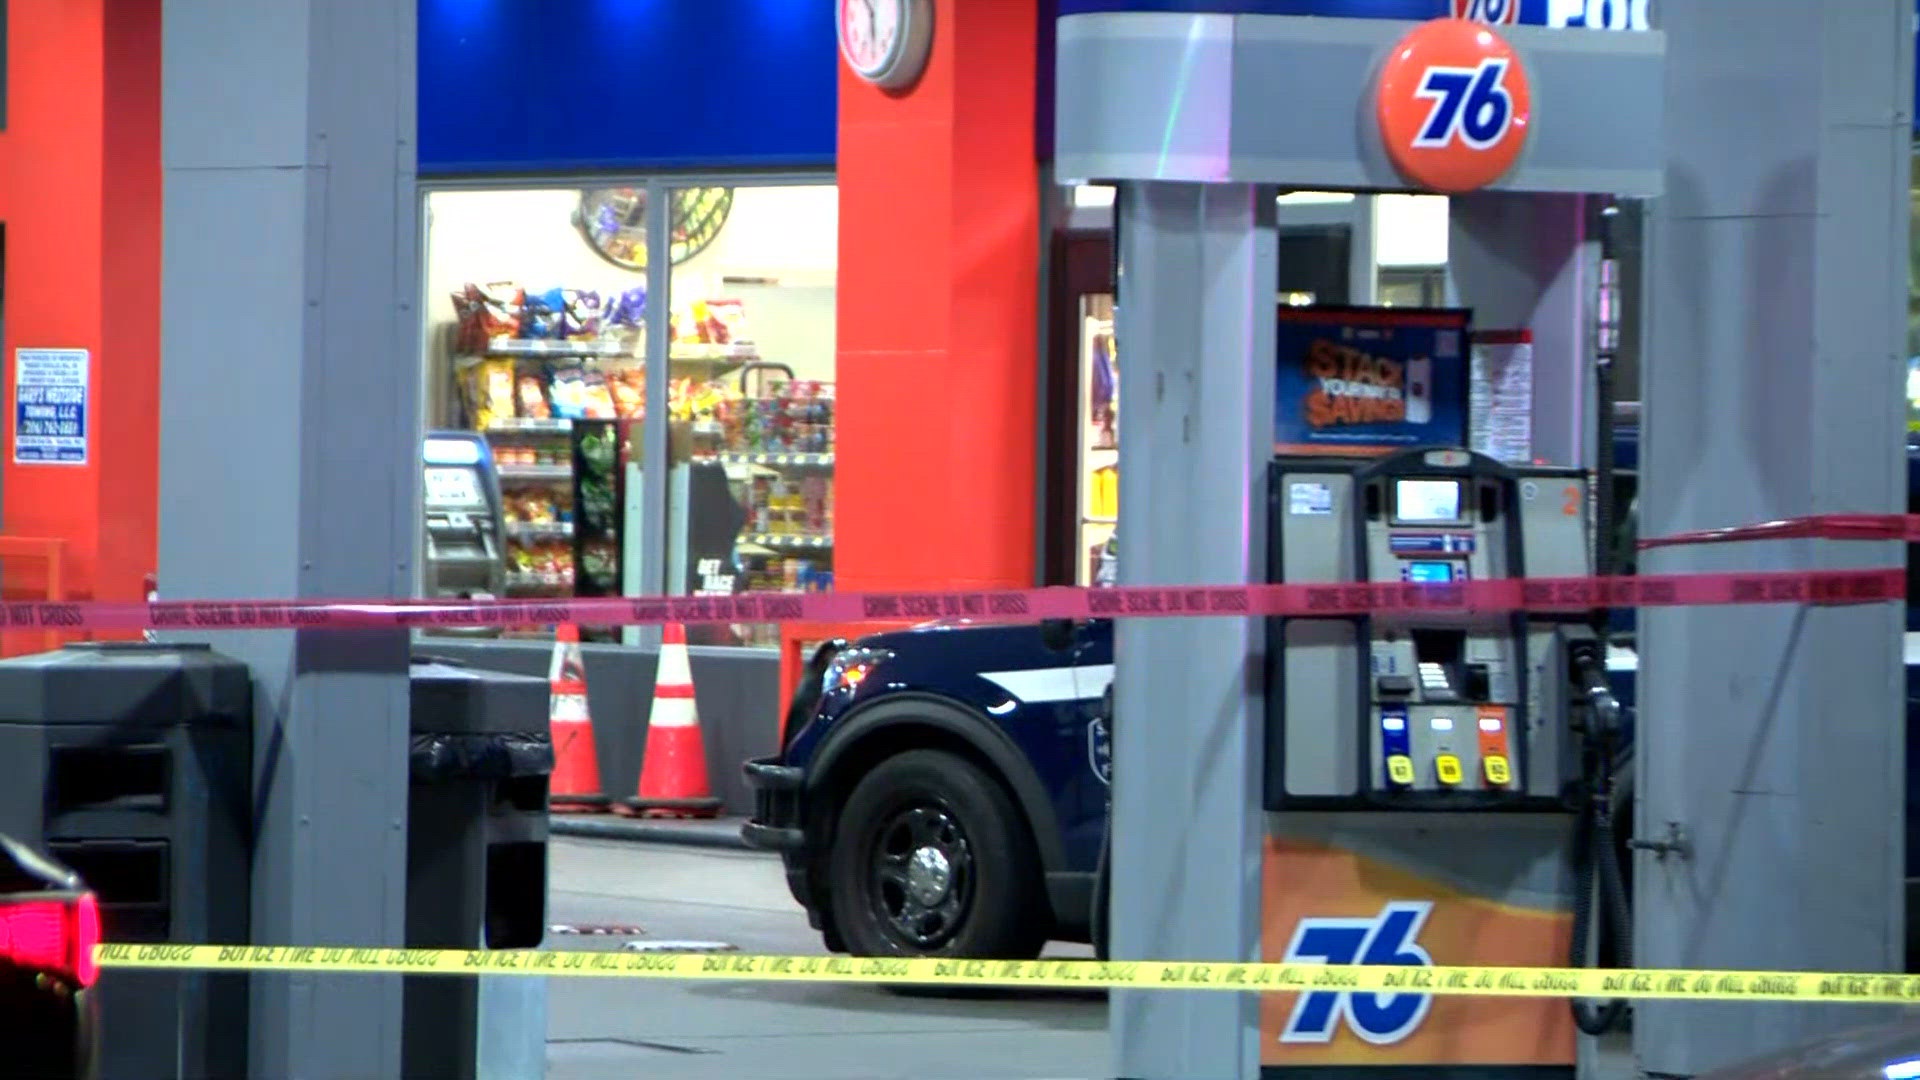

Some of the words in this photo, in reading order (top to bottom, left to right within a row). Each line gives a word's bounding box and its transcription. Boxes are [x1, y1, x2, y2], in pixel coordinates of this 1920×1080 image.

[1410, 57, 1513, 150] 76
[1562, 486, 1581, 515] 2
[40, 604, 83, 625] CROSS
[1278, 899, 1436, 1044] 76
